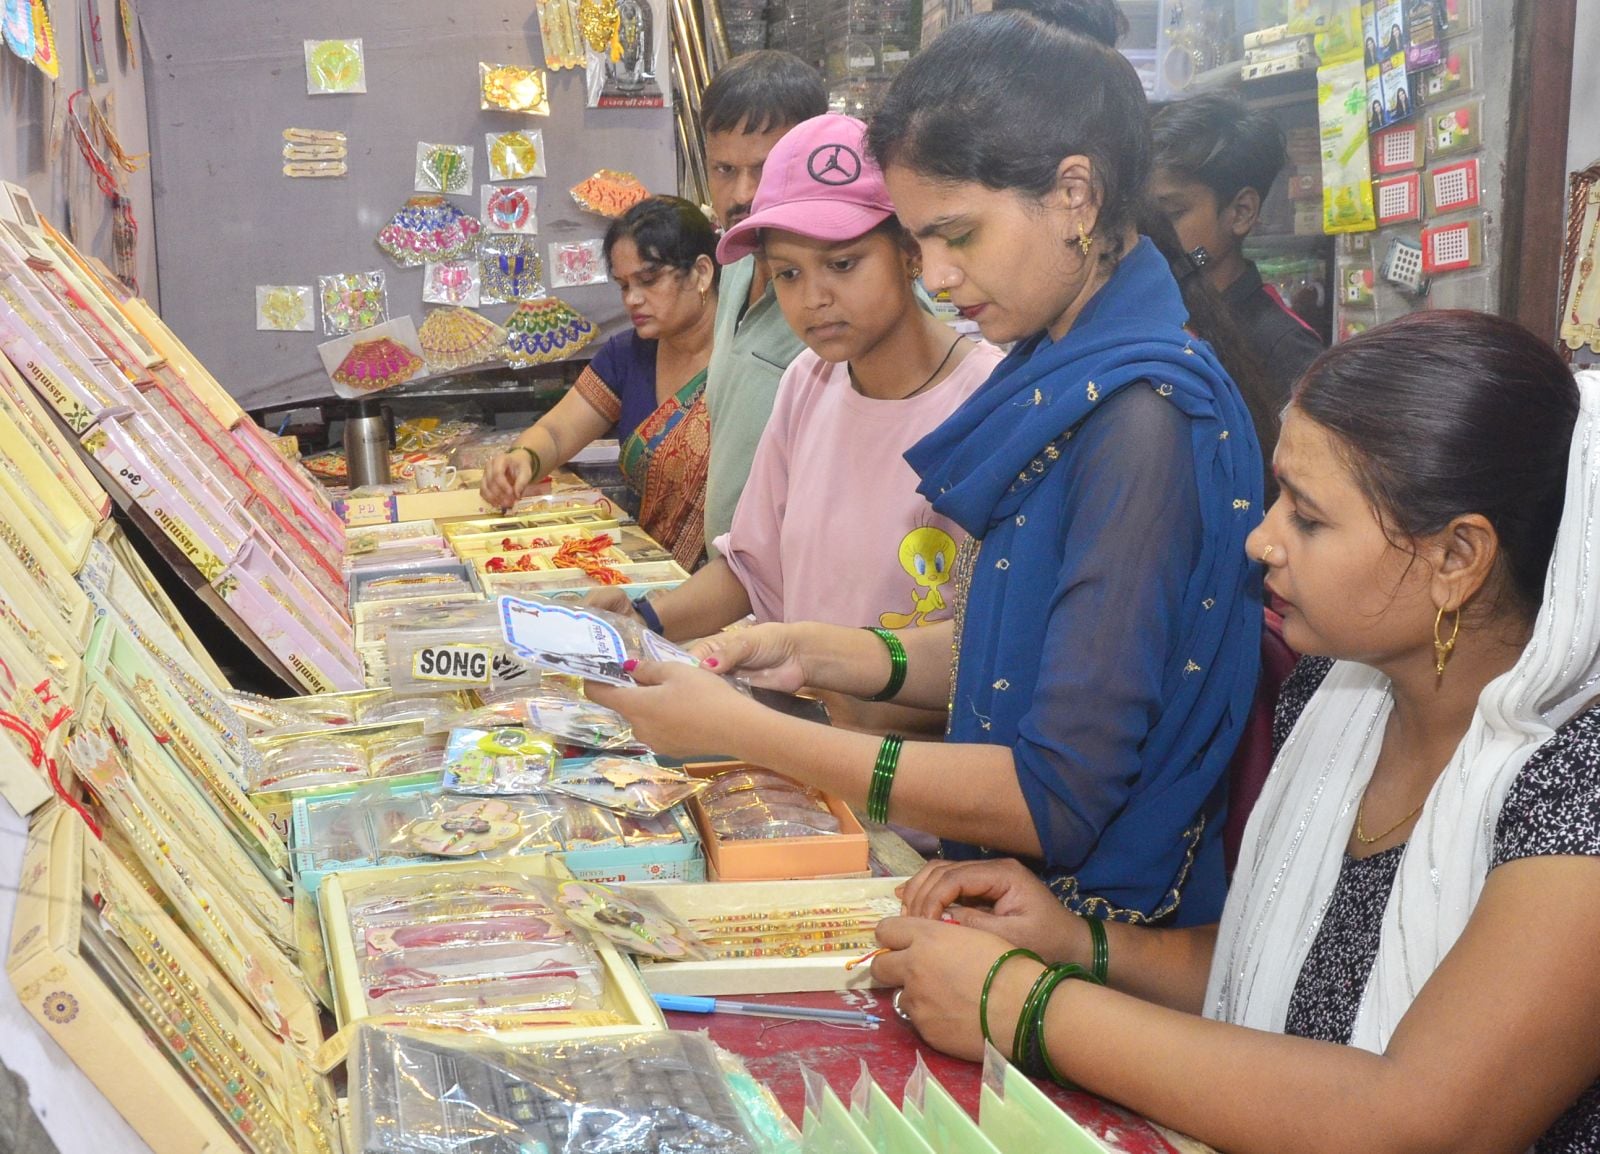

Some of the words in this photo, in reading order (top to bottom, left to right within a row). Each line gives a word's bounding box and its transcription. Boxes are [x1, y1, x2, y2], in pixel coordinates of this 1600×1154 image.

[26, 360, 67, 404] Jasmine
[119, 468, 142, 486] 300
[154, 507, 199, 556] Jasmine
[288, 653, 327, 694] Jasmine
[420, 648, 486, 678] SONG
